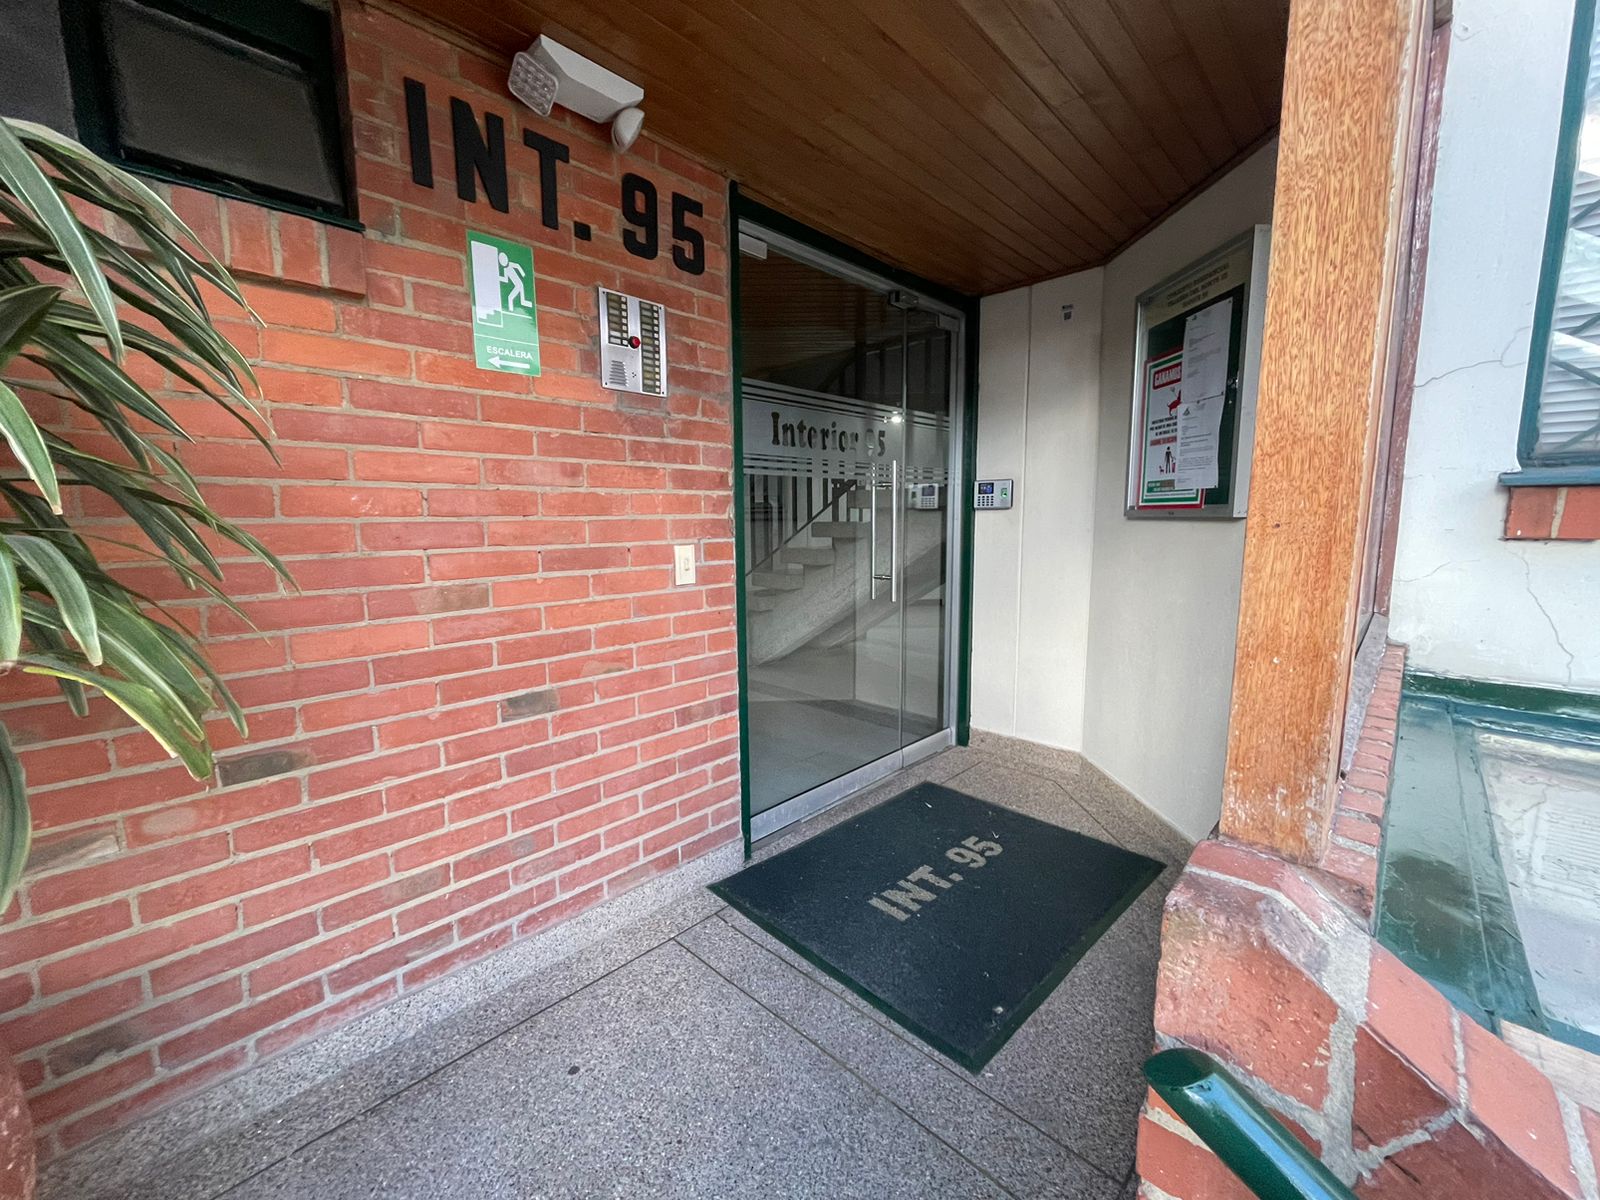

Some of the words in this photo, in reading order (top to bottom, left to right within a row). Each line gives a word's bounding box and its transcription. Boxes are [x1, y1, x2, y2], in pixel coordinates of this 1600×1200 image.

[403, 76, 592, 242] INT.
[620, 172, 706, 276] 95
[486, 345, 534, 361] ESCALERA
[771, 411, 859, 453] Interior
[868, 864, 964, 922] INT.
[945, 835, 1004, 869] 95
